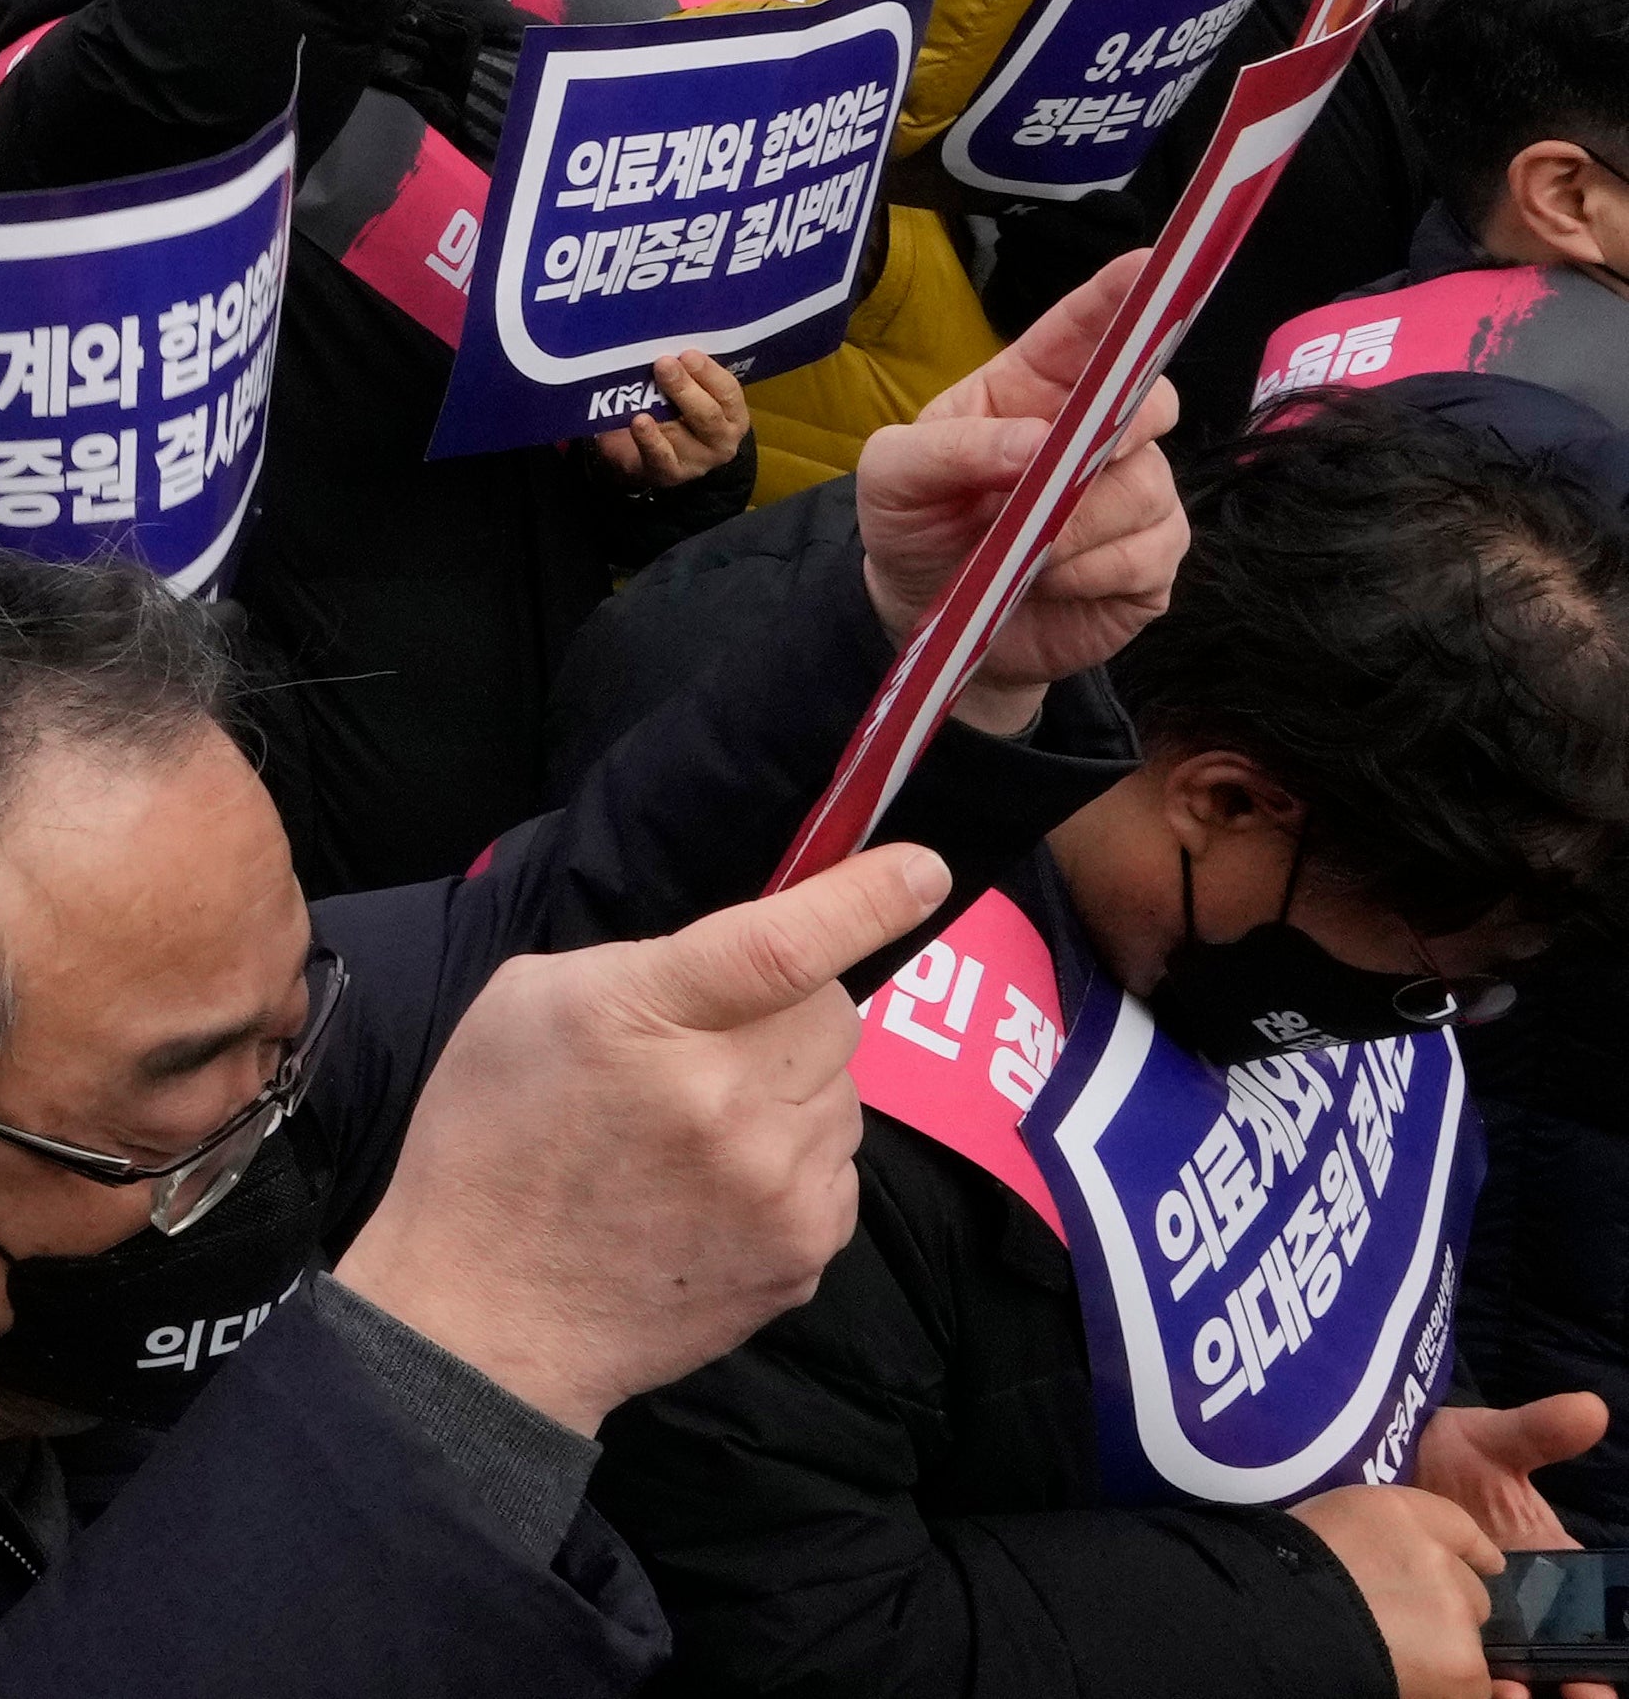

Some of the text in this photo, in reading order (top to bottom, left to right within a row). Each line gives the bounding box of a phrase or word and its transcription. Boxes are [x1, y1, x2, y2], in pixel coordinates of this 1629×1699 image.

[1011, 93, 1144, 149] 정부는
[1083, 23, 1157, 87] 9.4
[554, 78, 891, 214] 의료계와 합의없는
[534, 165, 868, 307] 의대증원 결사반대
[1191, 1122, 1372, 1427] 의대증원
